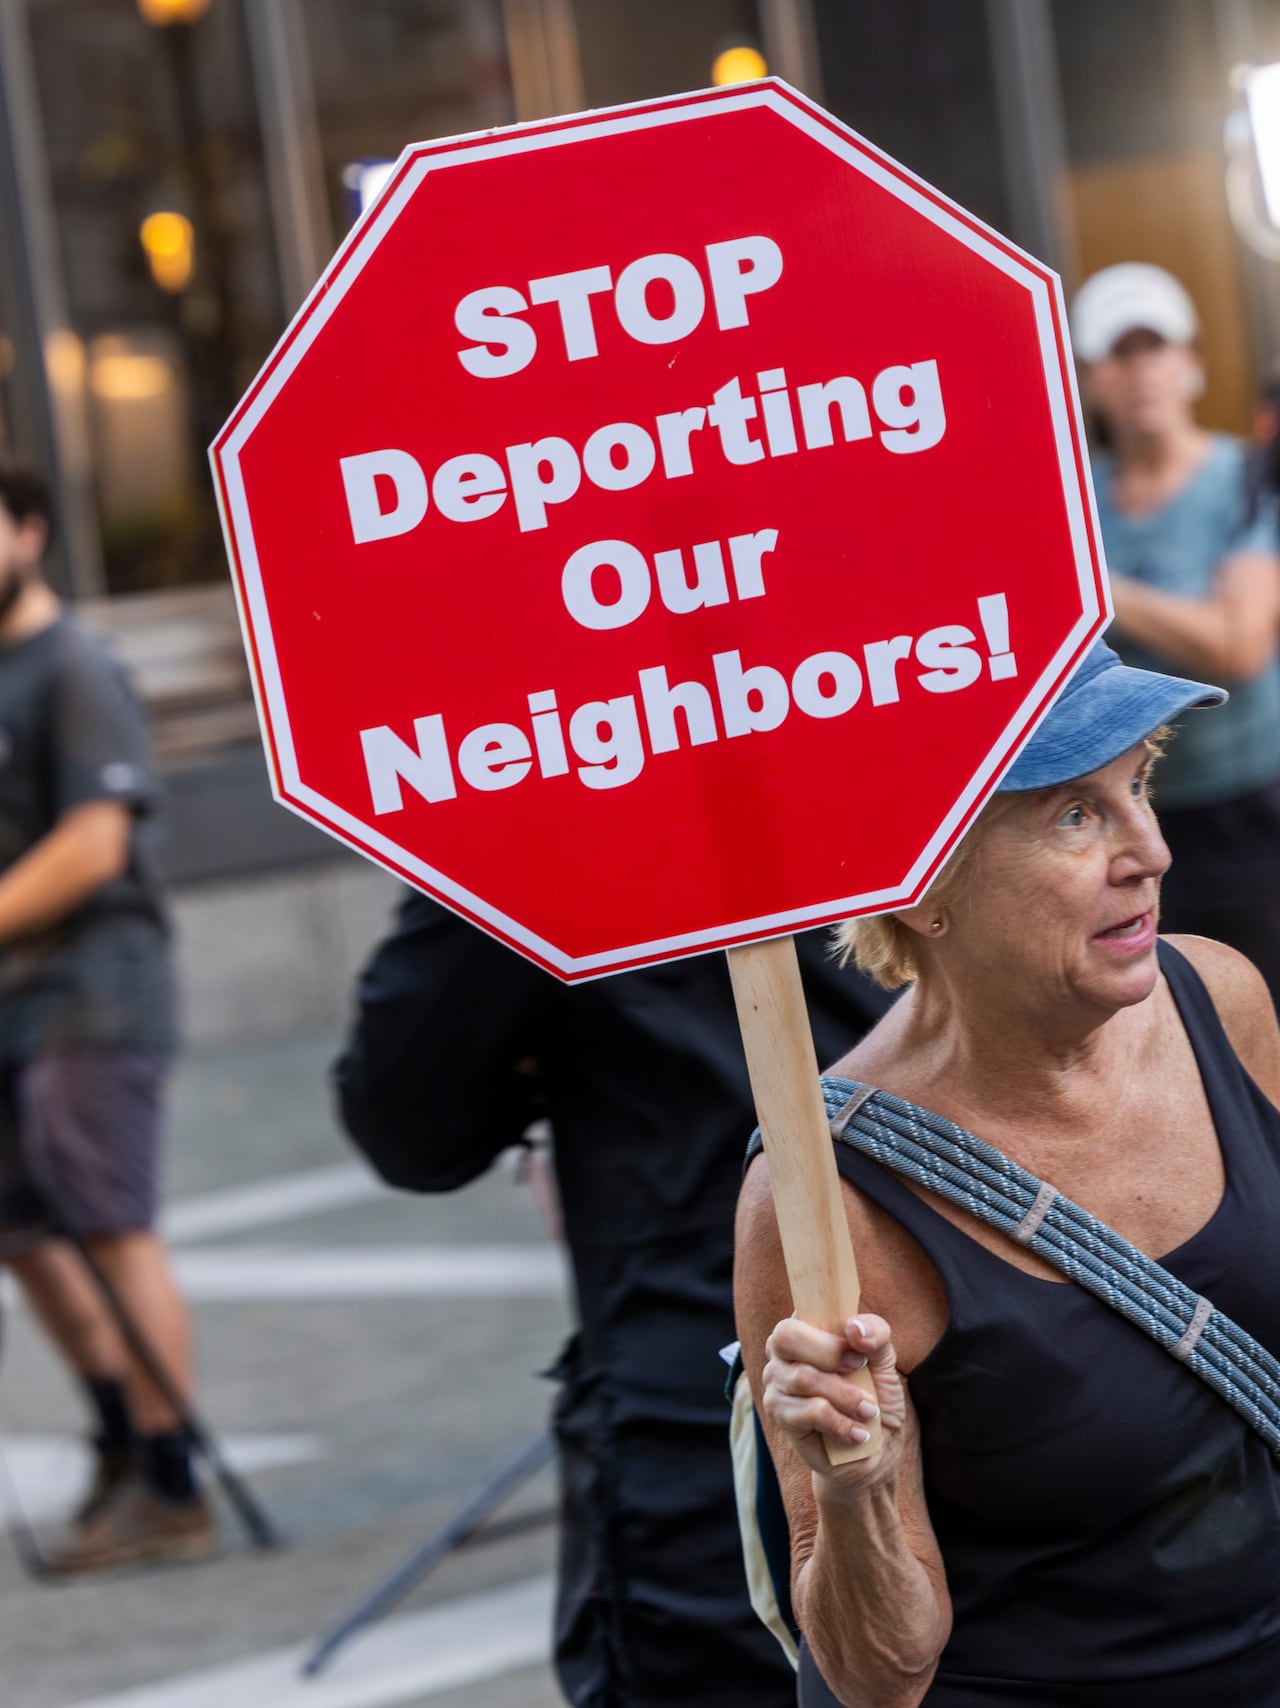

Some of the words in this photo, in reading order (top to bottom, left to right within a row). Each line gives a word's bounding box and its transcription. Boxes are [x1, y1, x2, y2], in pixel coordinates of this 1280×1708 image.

[454, 235, 783, 379] STOP
[340, 360, 947, 545] Deporting
[562, 529, 779, 630] Our
[360, 593, 1018, 816] Neighbors!
